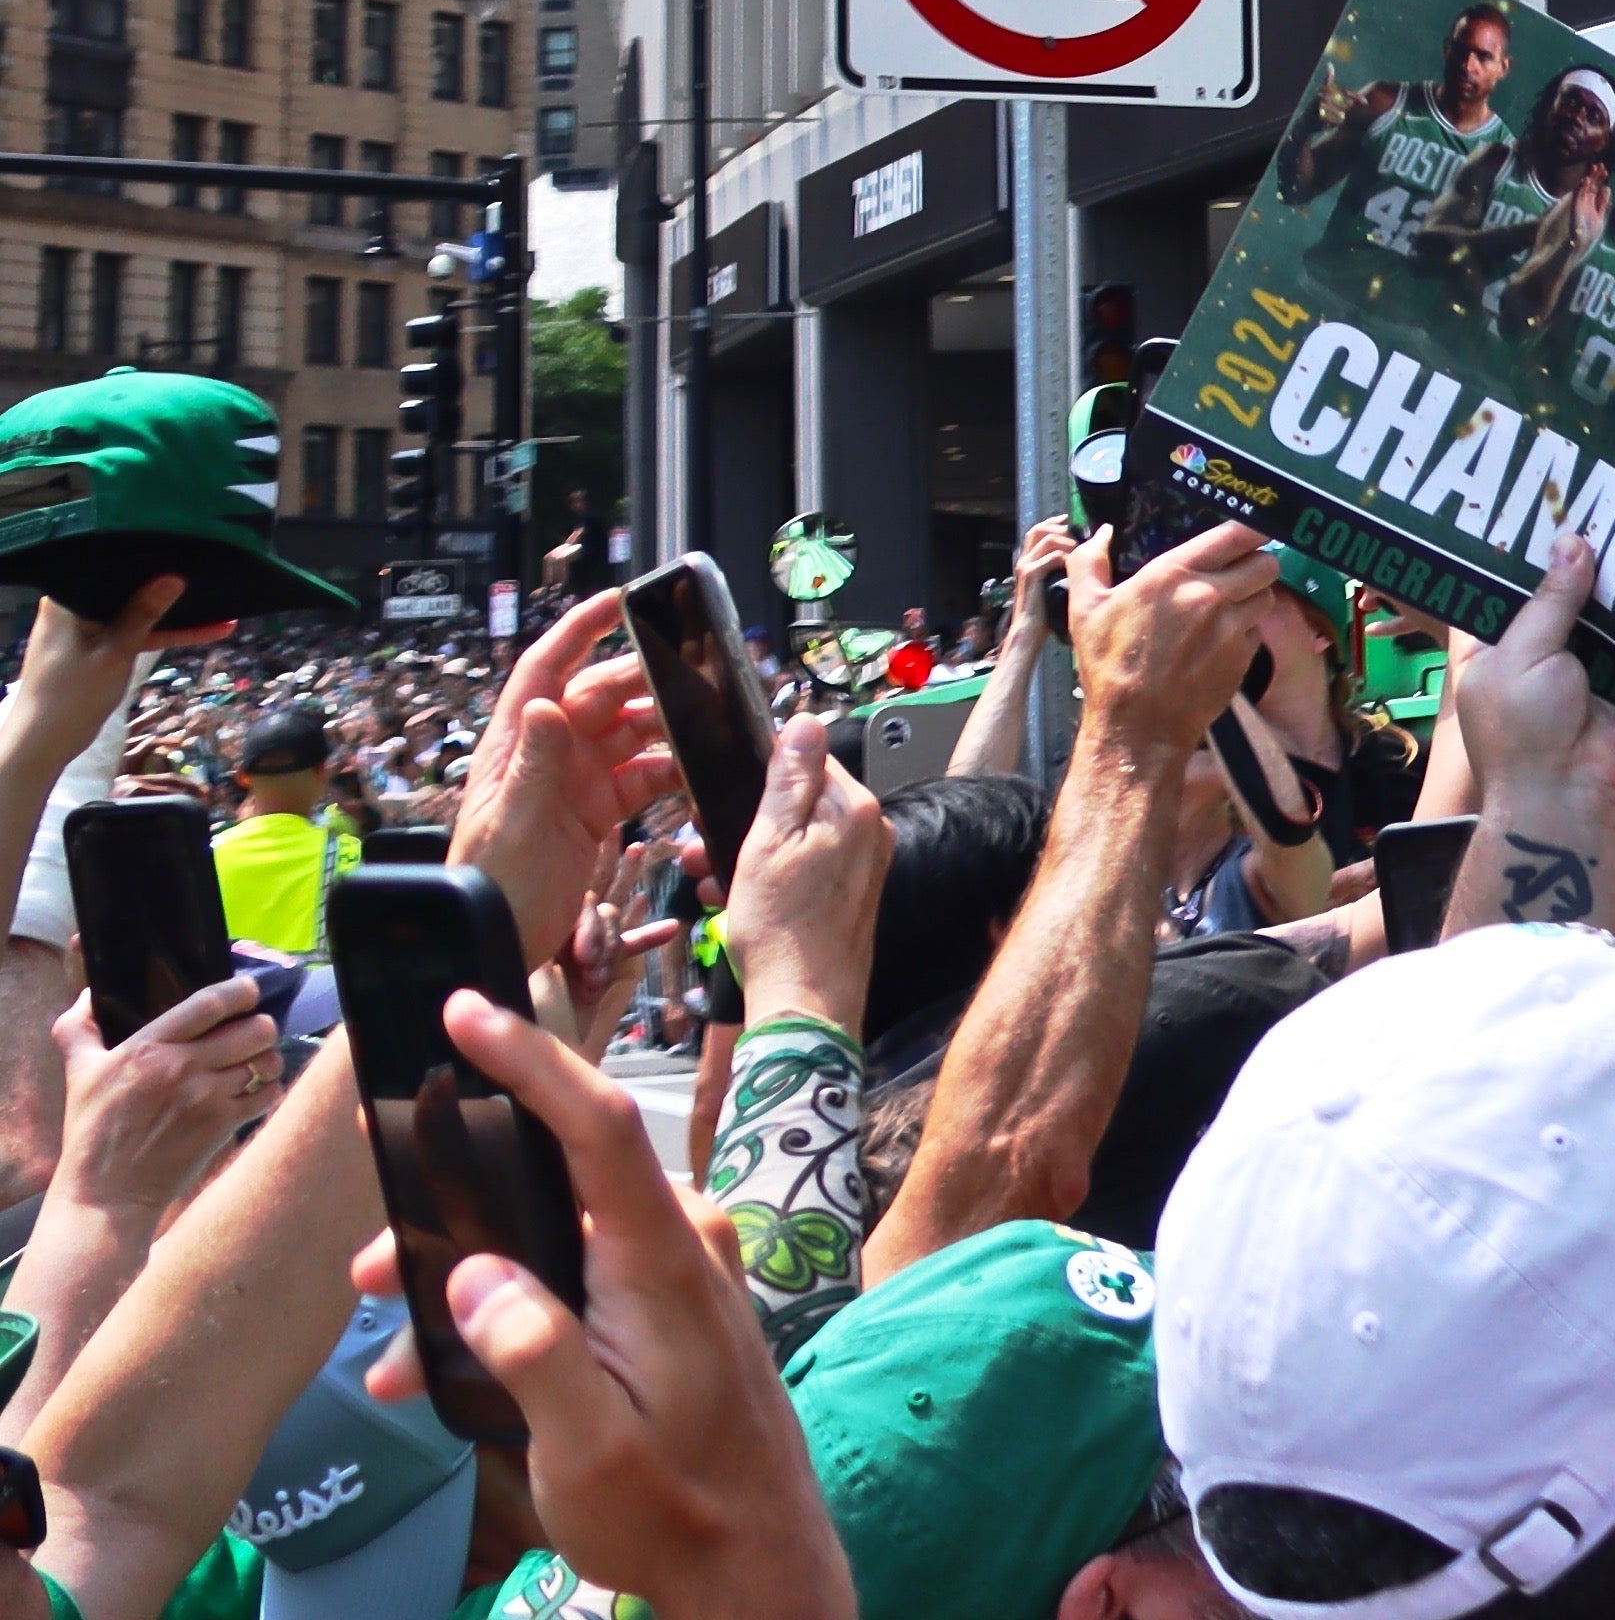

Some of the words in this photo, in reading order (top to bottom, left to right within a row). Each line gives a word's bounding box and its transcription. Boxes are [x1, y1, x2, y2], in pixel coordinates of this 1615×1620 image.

[1377, 132, 1466, 195] BOST
[1199, 287, 1311, 428] 2024
[1171, 468, 1254, 516] BOSTON
[1203, 458, 1279, 508] Sports
[1290, 506, 1507, 637] CONGRATS
[228, 1461, 367, 1545] leist
